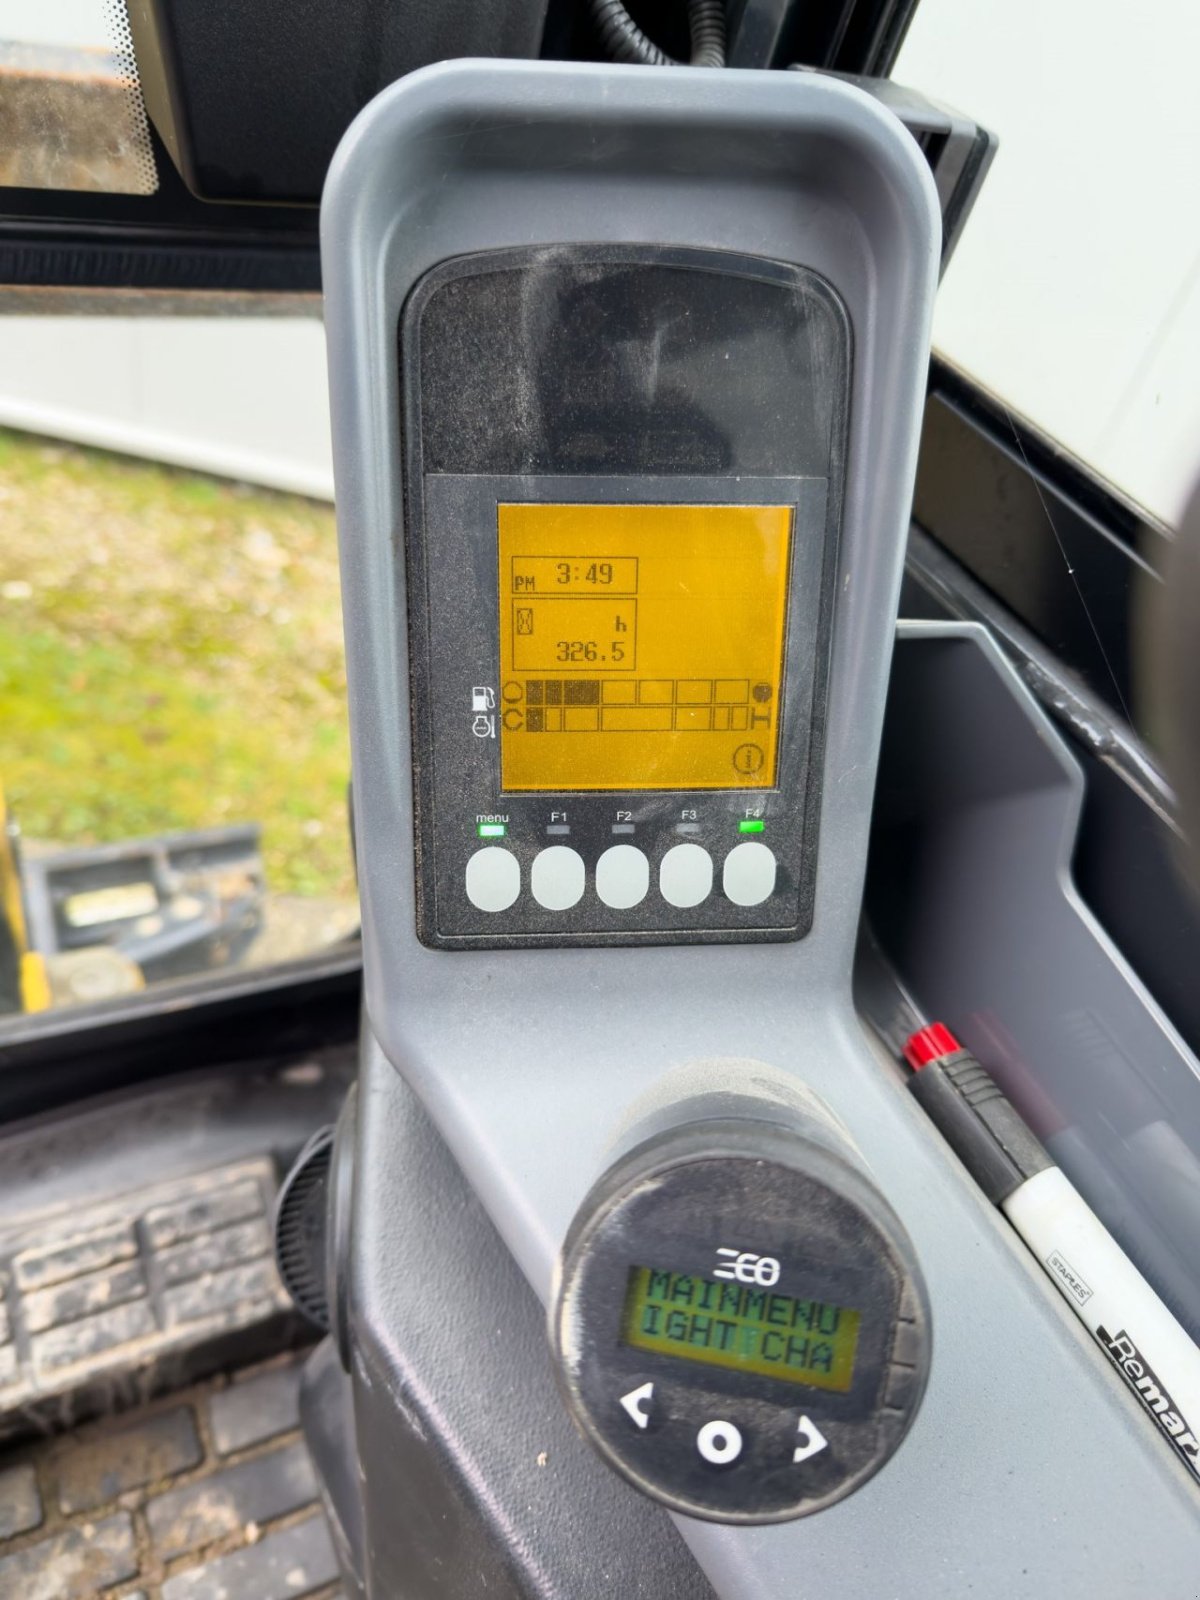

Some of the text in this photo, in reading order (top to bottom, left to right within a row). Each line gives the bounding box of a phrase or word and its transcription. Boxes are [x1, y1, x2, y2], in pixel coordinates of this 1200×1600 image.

[514, 563, 613, 591] PM 3:49
[615, 615, 627, 632] h
[556, 641, 625, 661] 326.5
[475, 813, 510, 823] menu
[550, 811, 568, 822] F1
[616, 811, 632, 822] F2
[681, 809, 697, 820] F3
[745, 808, 760, 819] F4
[1052, 1256, 1090, 1300] STAPLES
[646, 1268, 841, 1336] MAINMENU
[642, 1304, 834, 1373] IGHT CHA
